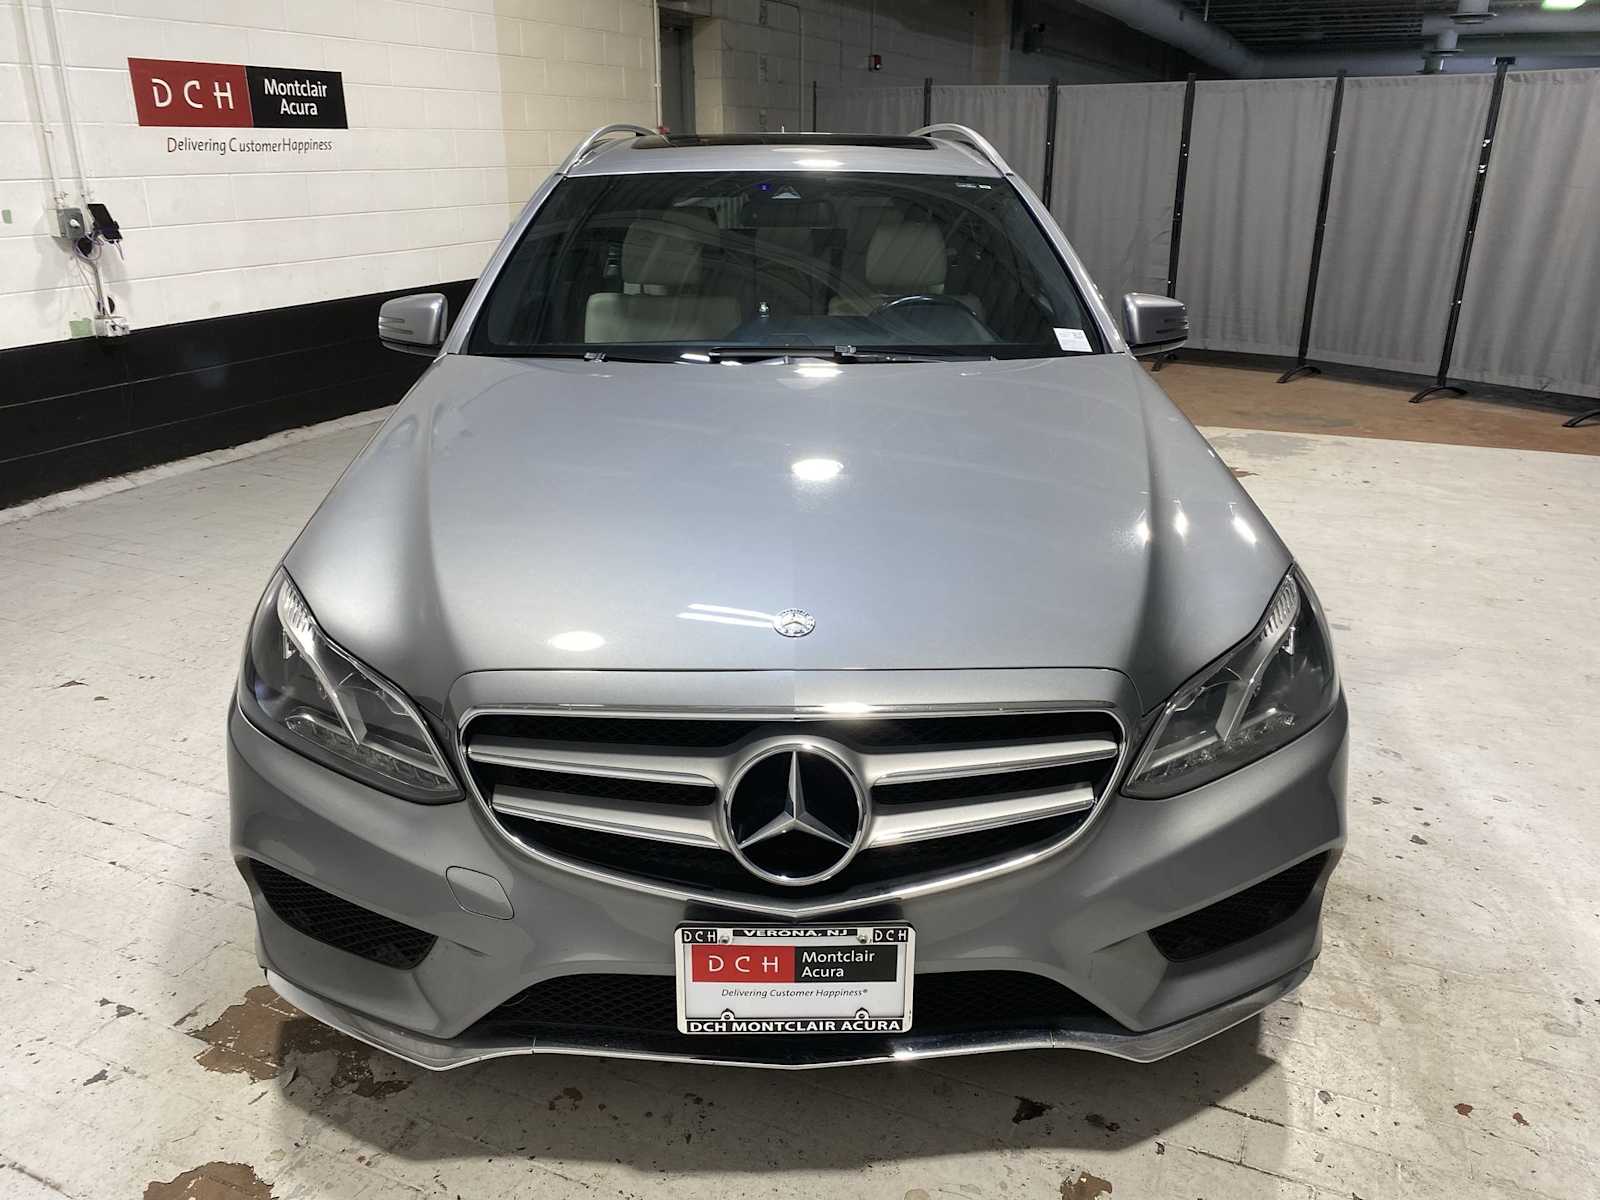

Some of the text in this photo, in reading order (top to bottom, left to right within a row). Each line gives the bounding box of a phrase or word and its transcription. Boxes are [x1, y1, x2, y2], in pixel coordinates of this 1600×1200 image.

[151, 78, 235, 110] DCH
[264, 78, 328, 98] Montclair
[280, 99, 318, 116] Acura
[167, 137, 226, 155] Delivering
[683, 930, 717, 943] DCH
[826, 929, 848, 937] NJ
[874, 929, 908, 942] DCH
[802, 949, 876, 963] Montclair
[708, 955, 779, 973] DCH
[801, 966, 845, 978] Acura
[721, 988, 768, 999] Delivering
[769, 988, 813, 998] Customer
[689, 1020, 901, 1032] DCH MONTCLAIR ACURA
